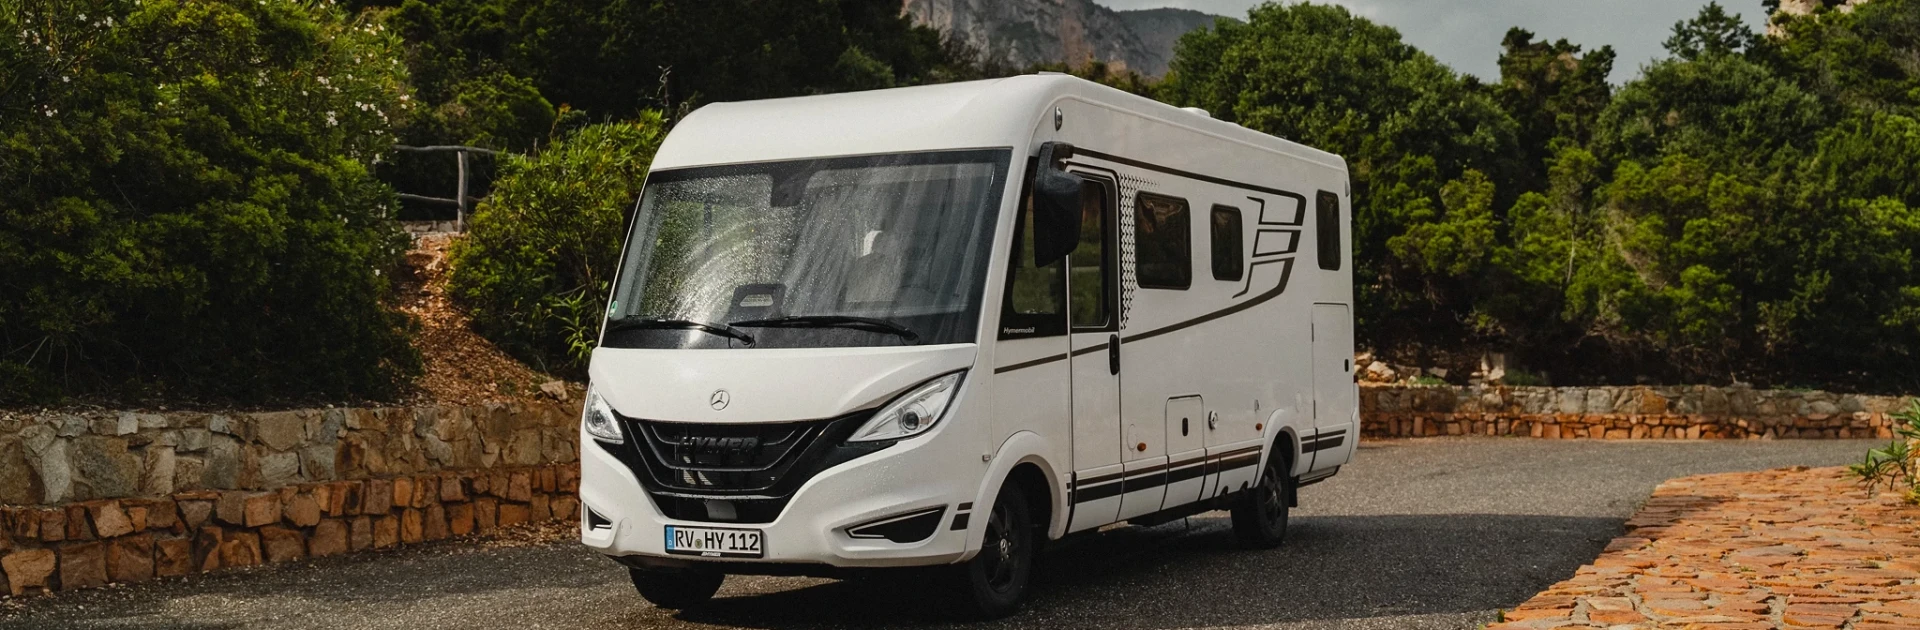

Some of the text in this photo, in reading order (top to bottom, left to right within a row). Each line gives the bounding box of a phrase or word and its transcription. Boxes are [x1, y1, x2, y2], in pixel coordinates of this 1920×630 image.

[675, 530, 694, 548] RV
[704, 531, 724, 549] HY
[728, 532, 759, 551] 112
